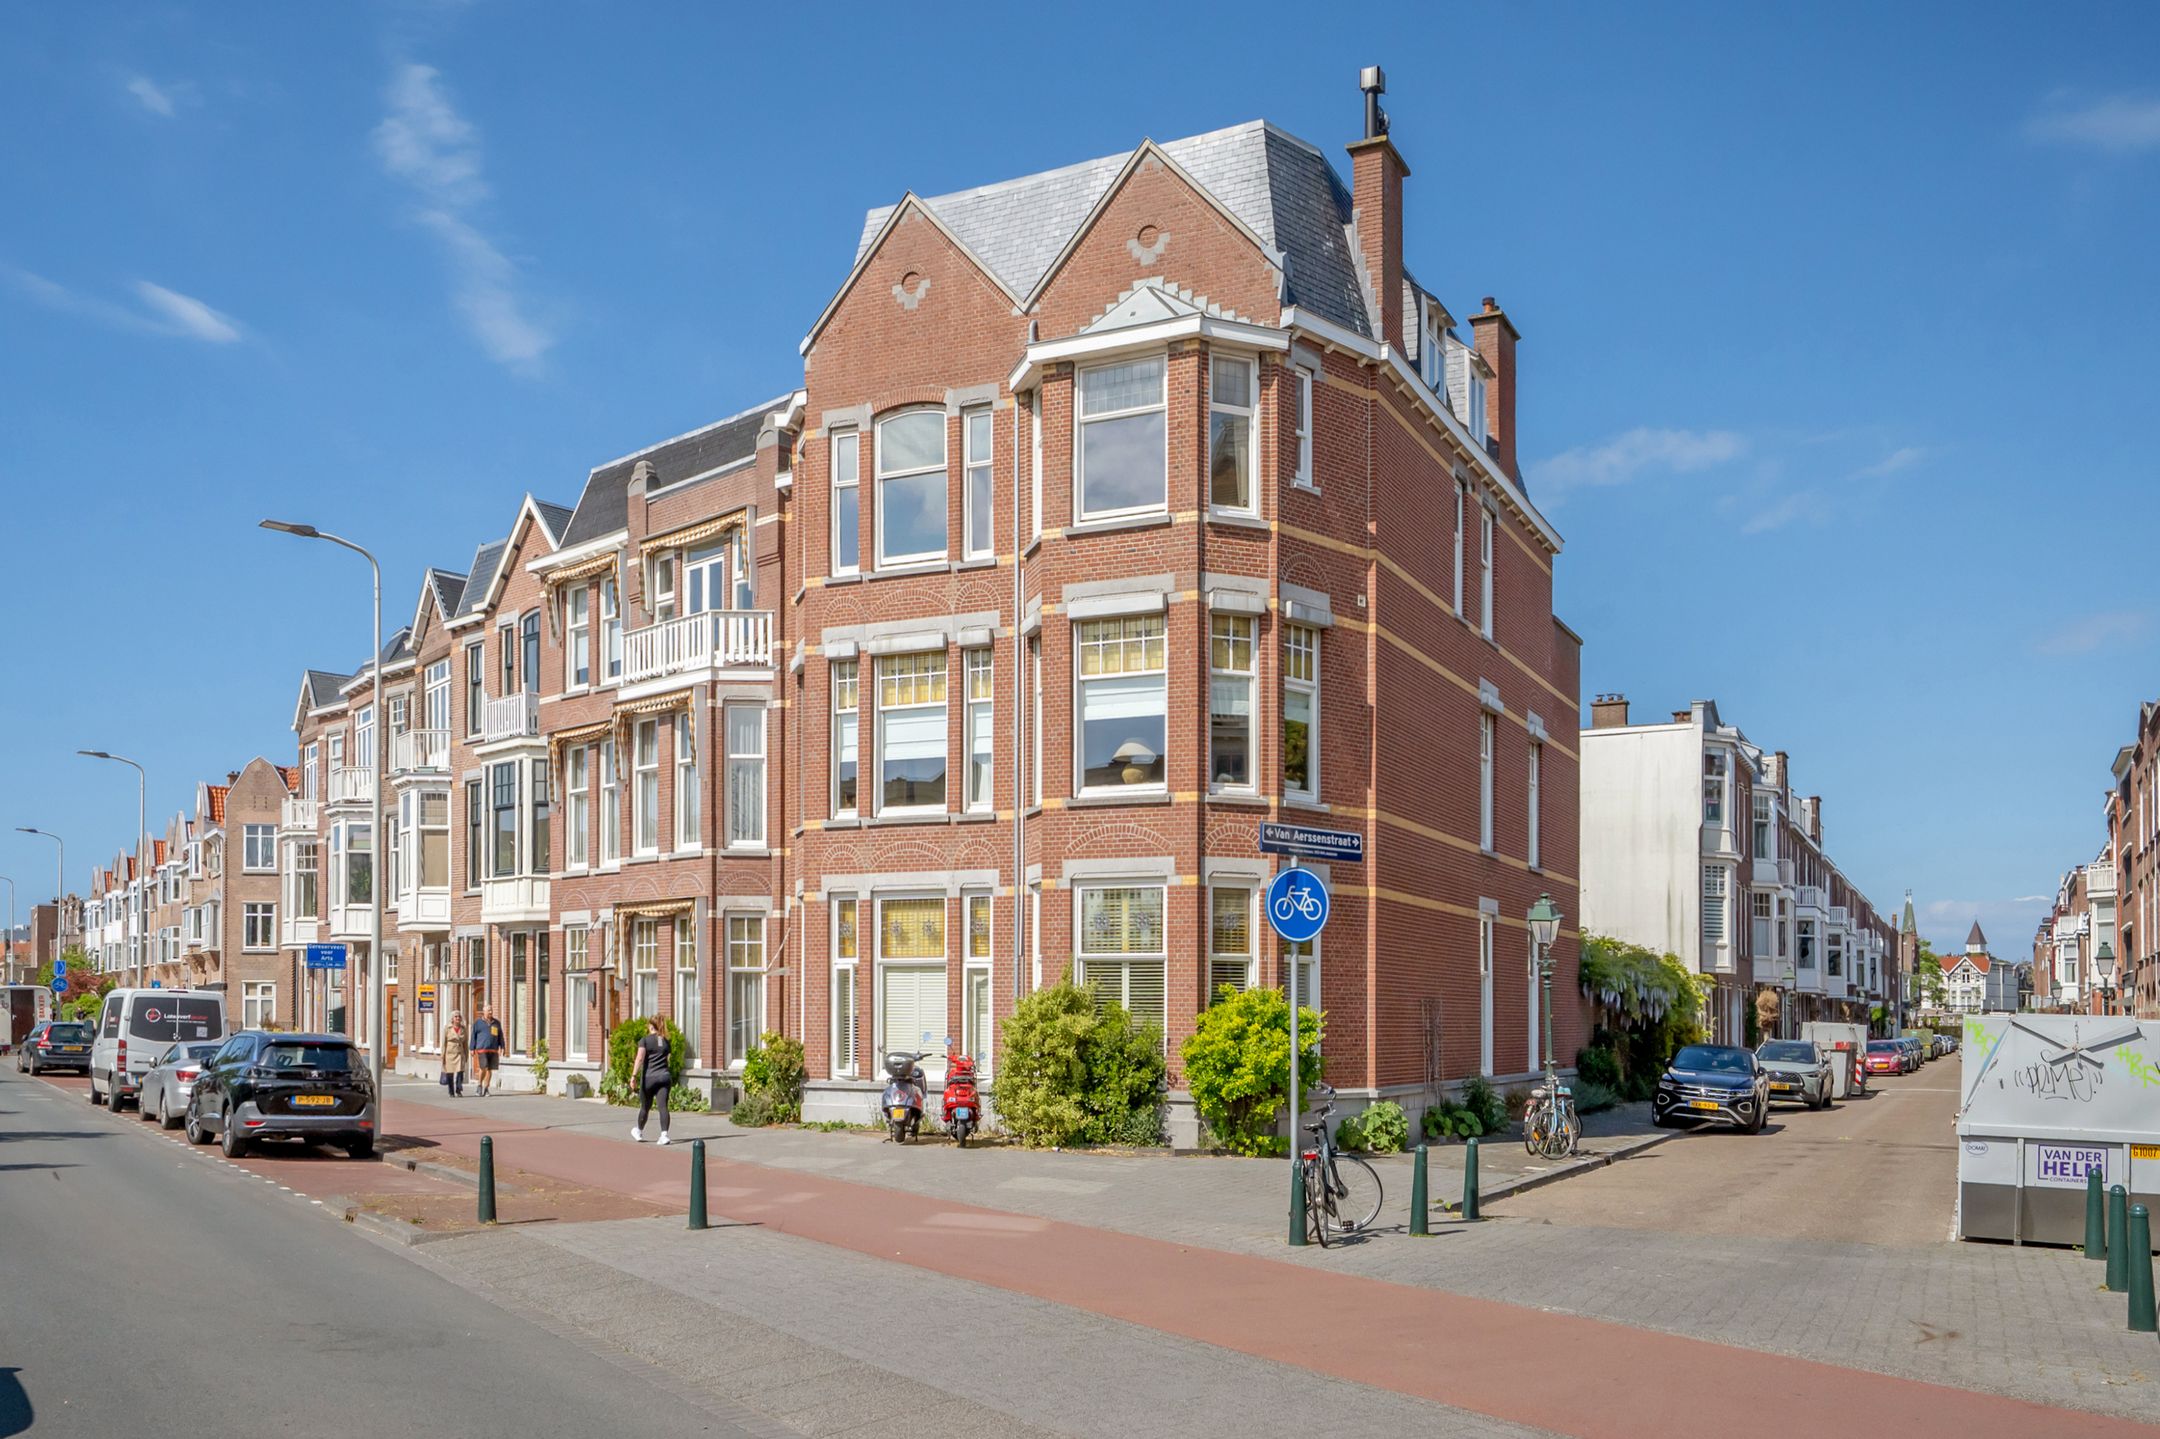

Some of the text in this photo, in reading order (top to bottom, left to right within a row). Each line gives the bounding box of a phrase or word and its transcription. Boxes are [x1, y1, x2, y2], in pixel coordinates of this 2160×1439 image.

[1274, 827, 1352, 847] Van Aerssenstraat
[2045, 1149, 2102, 1162] VAN DER
[2133, 1146, 2158, 1158] G1007
